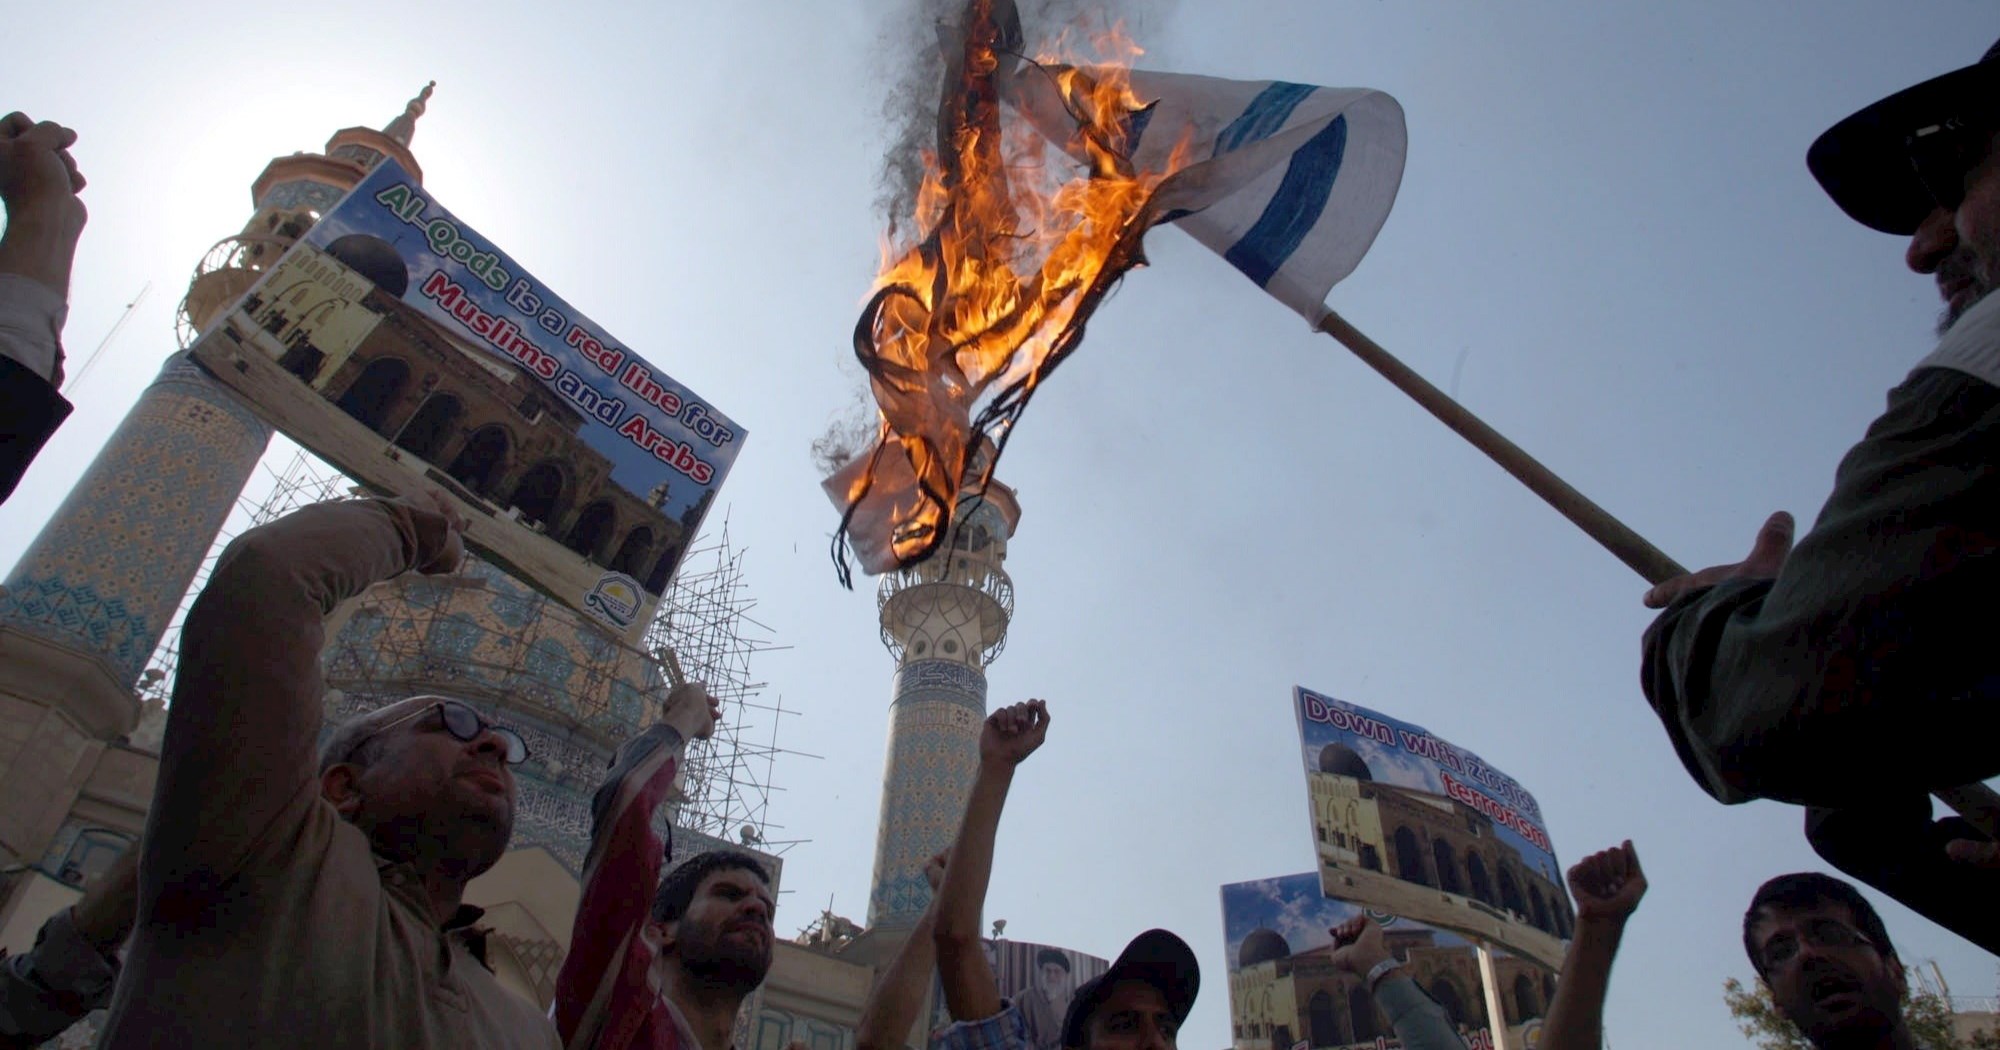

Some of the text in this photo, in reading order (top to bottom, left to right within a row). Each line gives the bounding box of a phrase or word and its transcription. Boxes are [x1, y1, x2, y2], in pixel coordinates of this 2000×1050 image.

[375, 183, 734, 447] Al-Qods is a red line for
[421, 270, 715, 486] Muslims and Arabs
[1303, 693, 1397, 747] Down
[1399, 729, 1465, 776] with
[1441, 770, 1552, 855] terrorism
